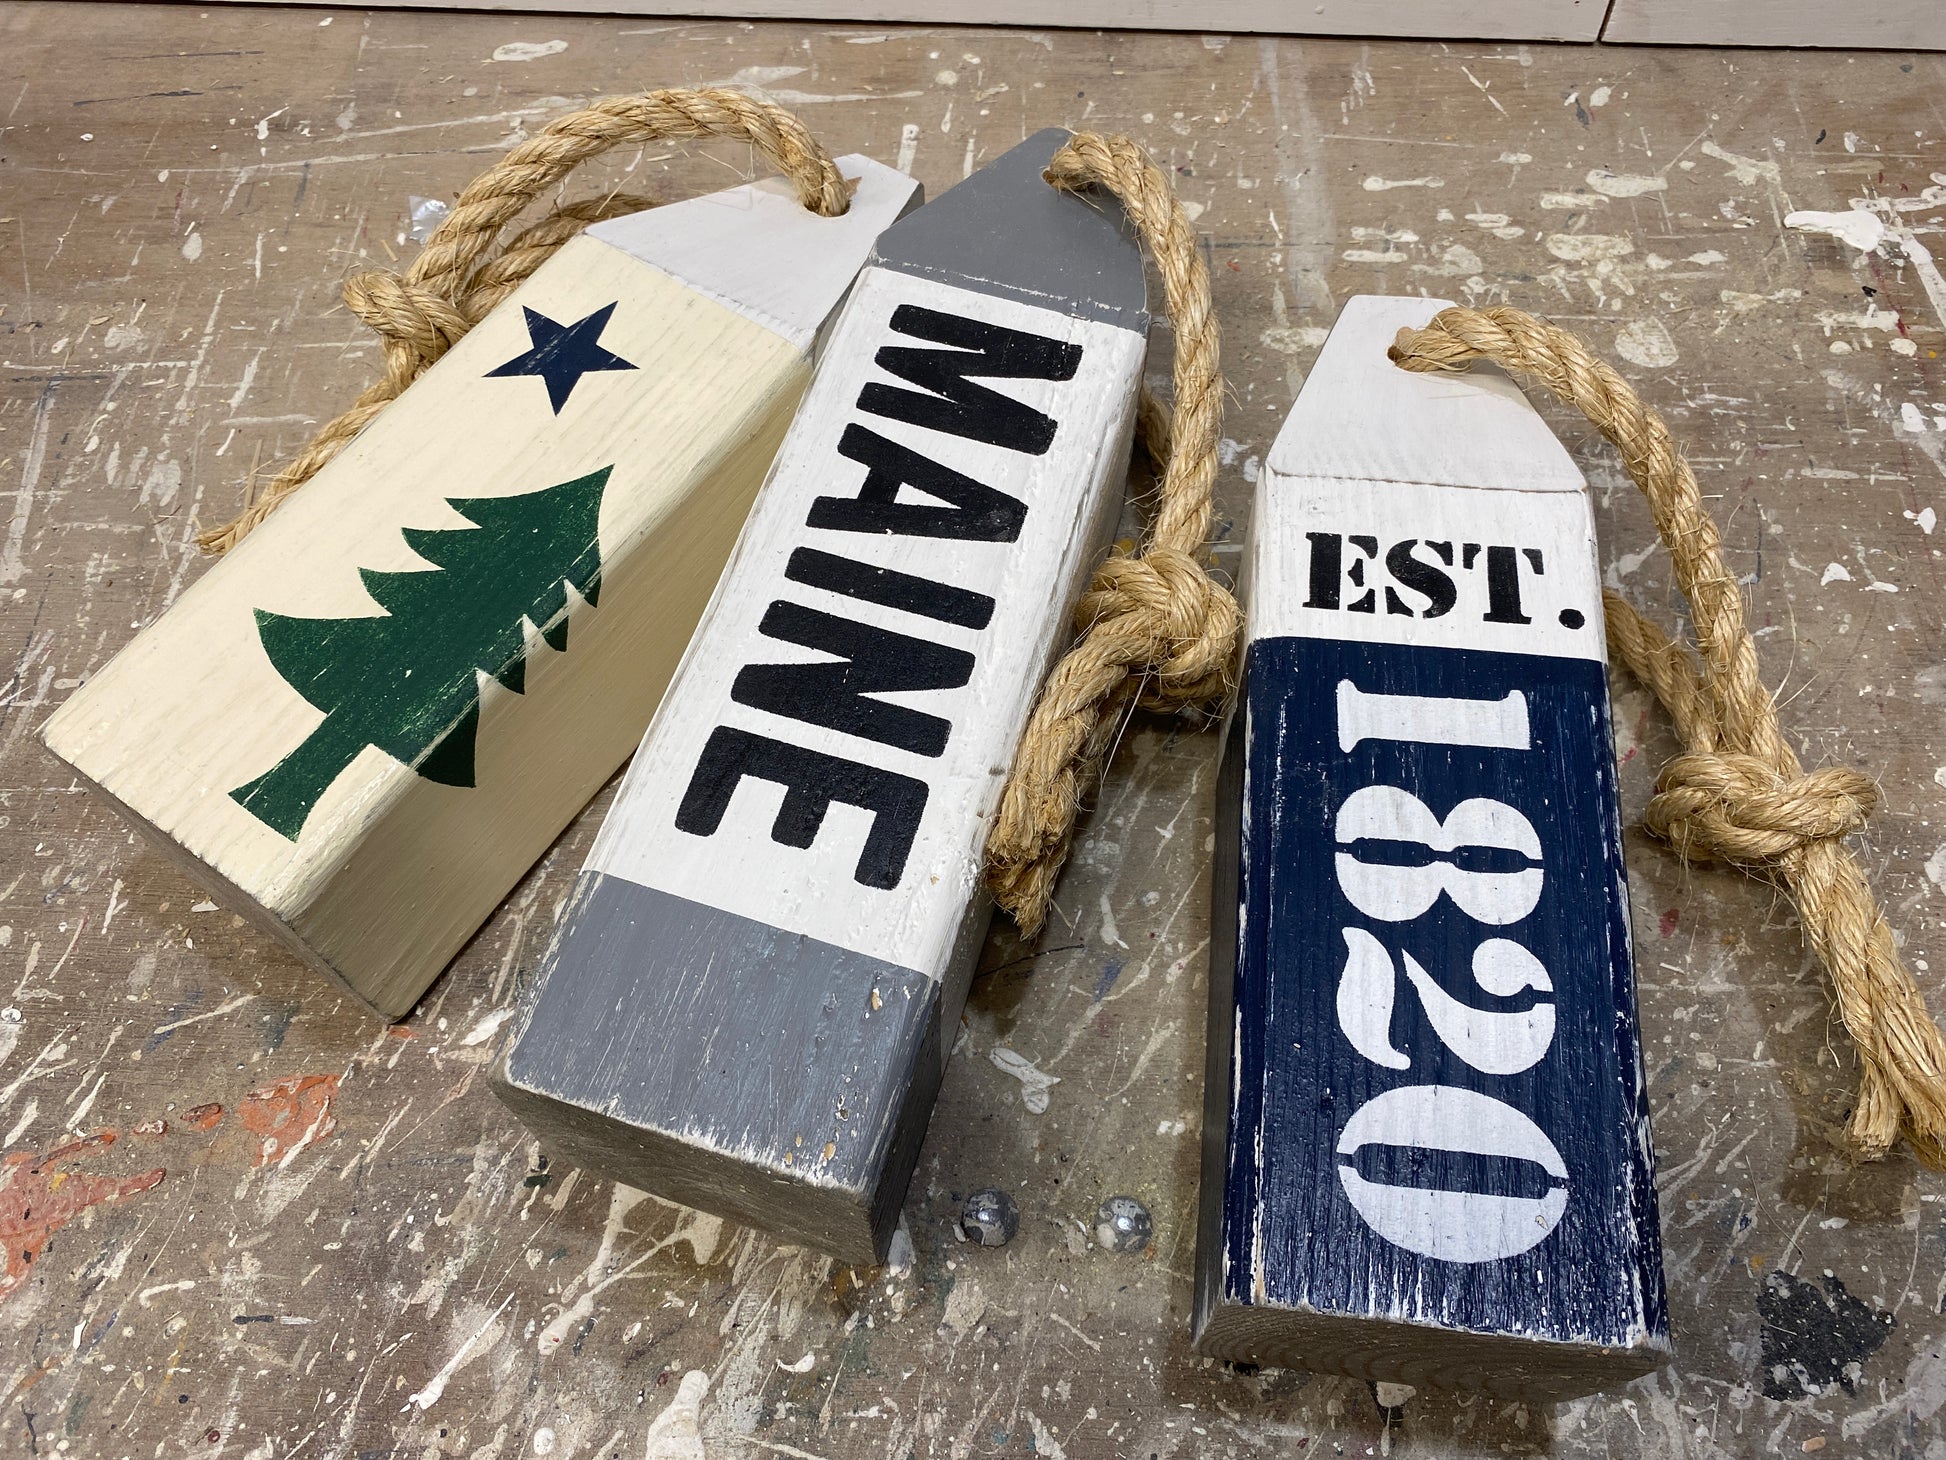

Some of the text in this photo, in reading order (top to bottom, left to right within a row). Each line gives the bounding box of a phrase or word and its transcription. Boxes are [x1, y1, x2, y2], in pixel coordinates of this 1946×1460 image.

[675, 303, 1083, 891] MAINE
[1302, 531, 1586, 630] EST.
[1335, 679, 1570, 1264] 1820
